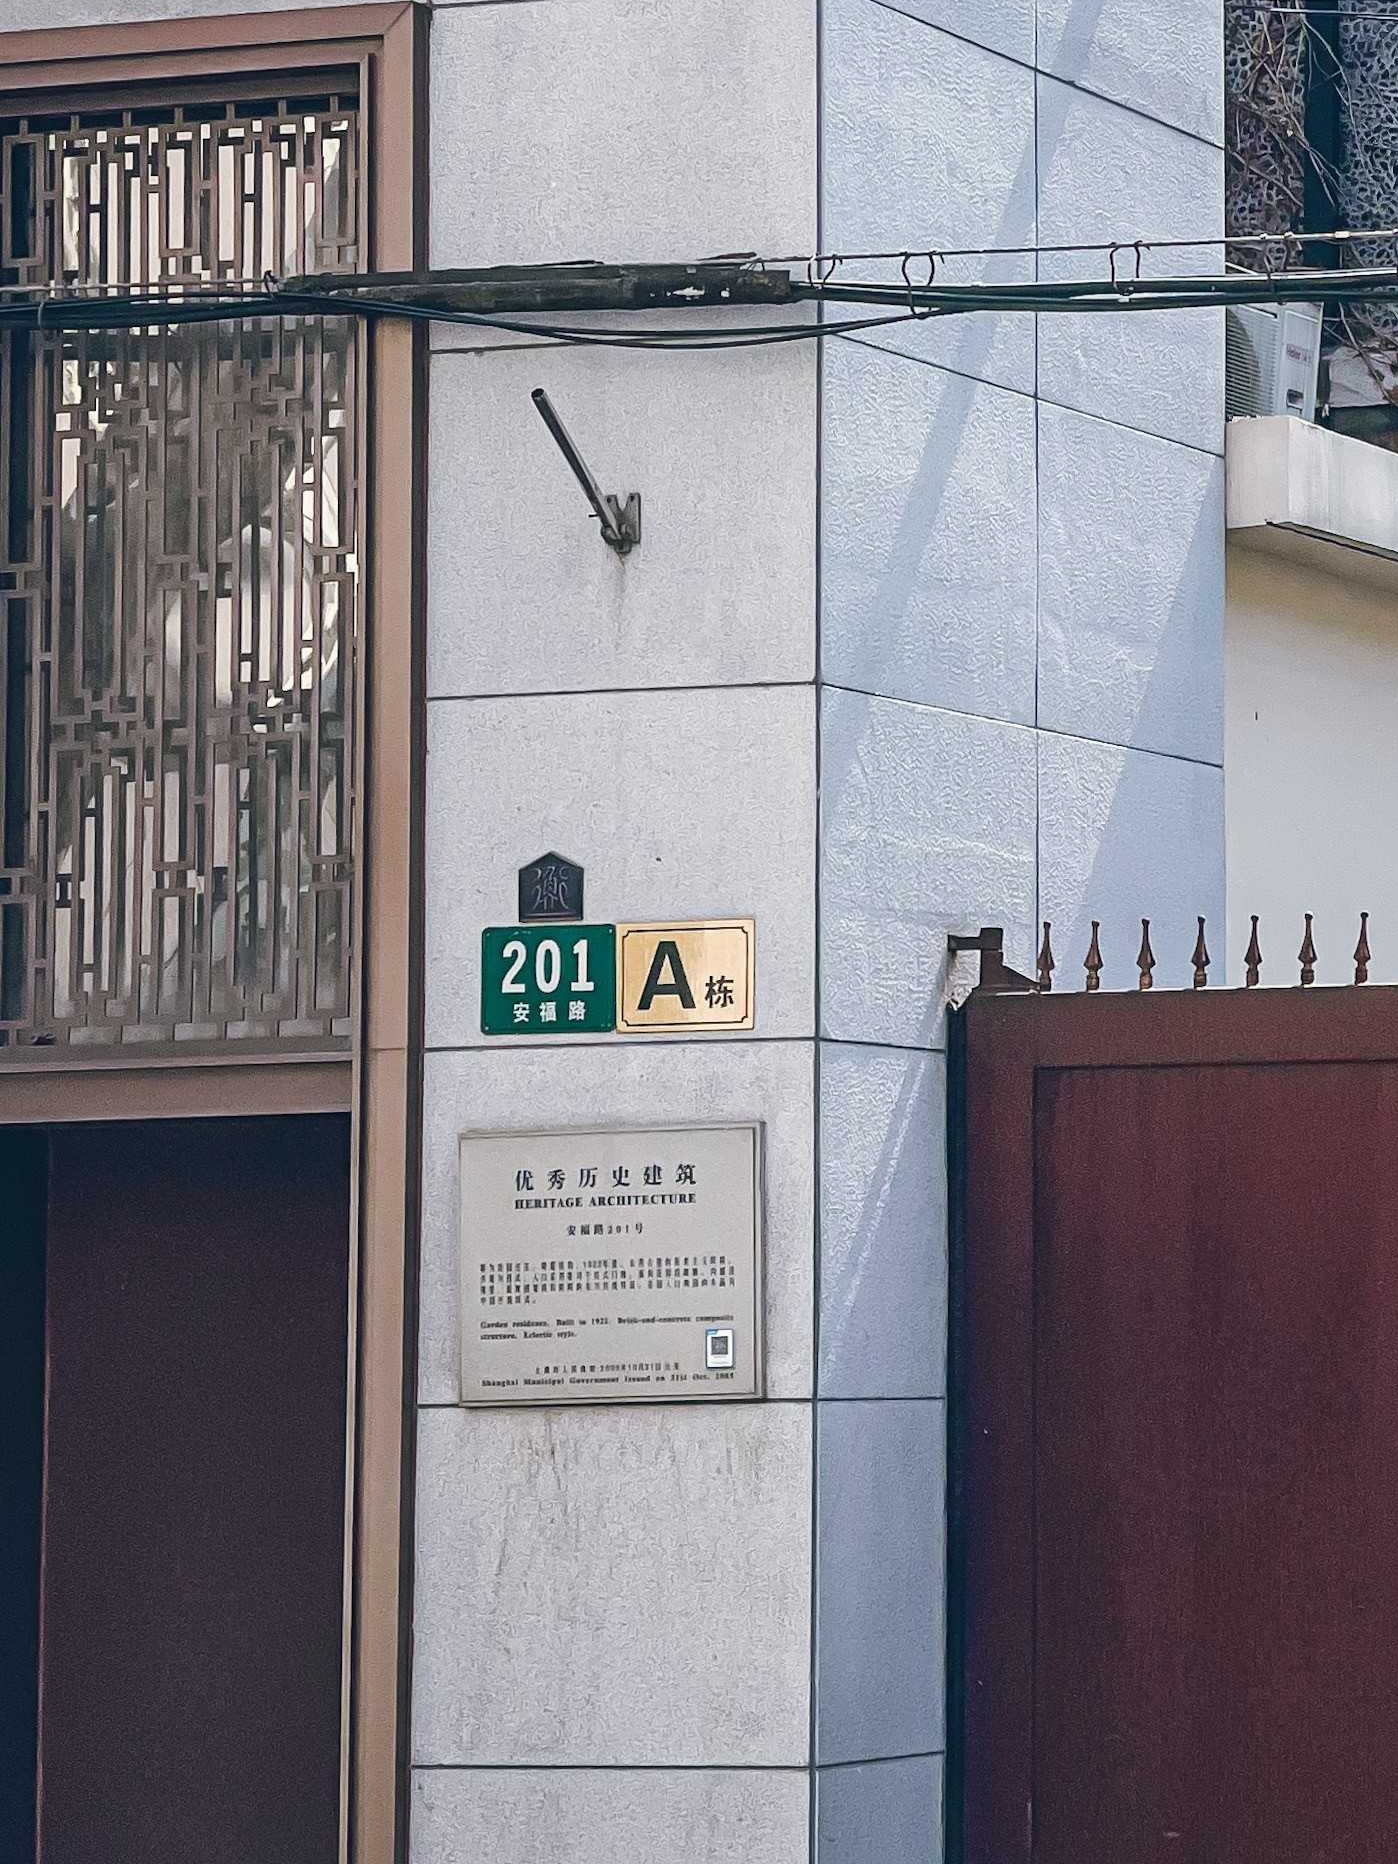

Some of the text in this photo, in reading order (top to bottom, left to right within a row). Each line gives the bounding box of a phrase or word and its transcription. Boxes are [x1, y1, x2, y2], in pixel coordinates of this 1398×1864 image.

[501, 939, 595, 994] 201
[512, 1000, 587, 1023] 安福路
[515, 1163, 697, 1192] 优秀历史建筑
[514, 1192, 697, 1210] HERITAGE ARCHITECTURE
